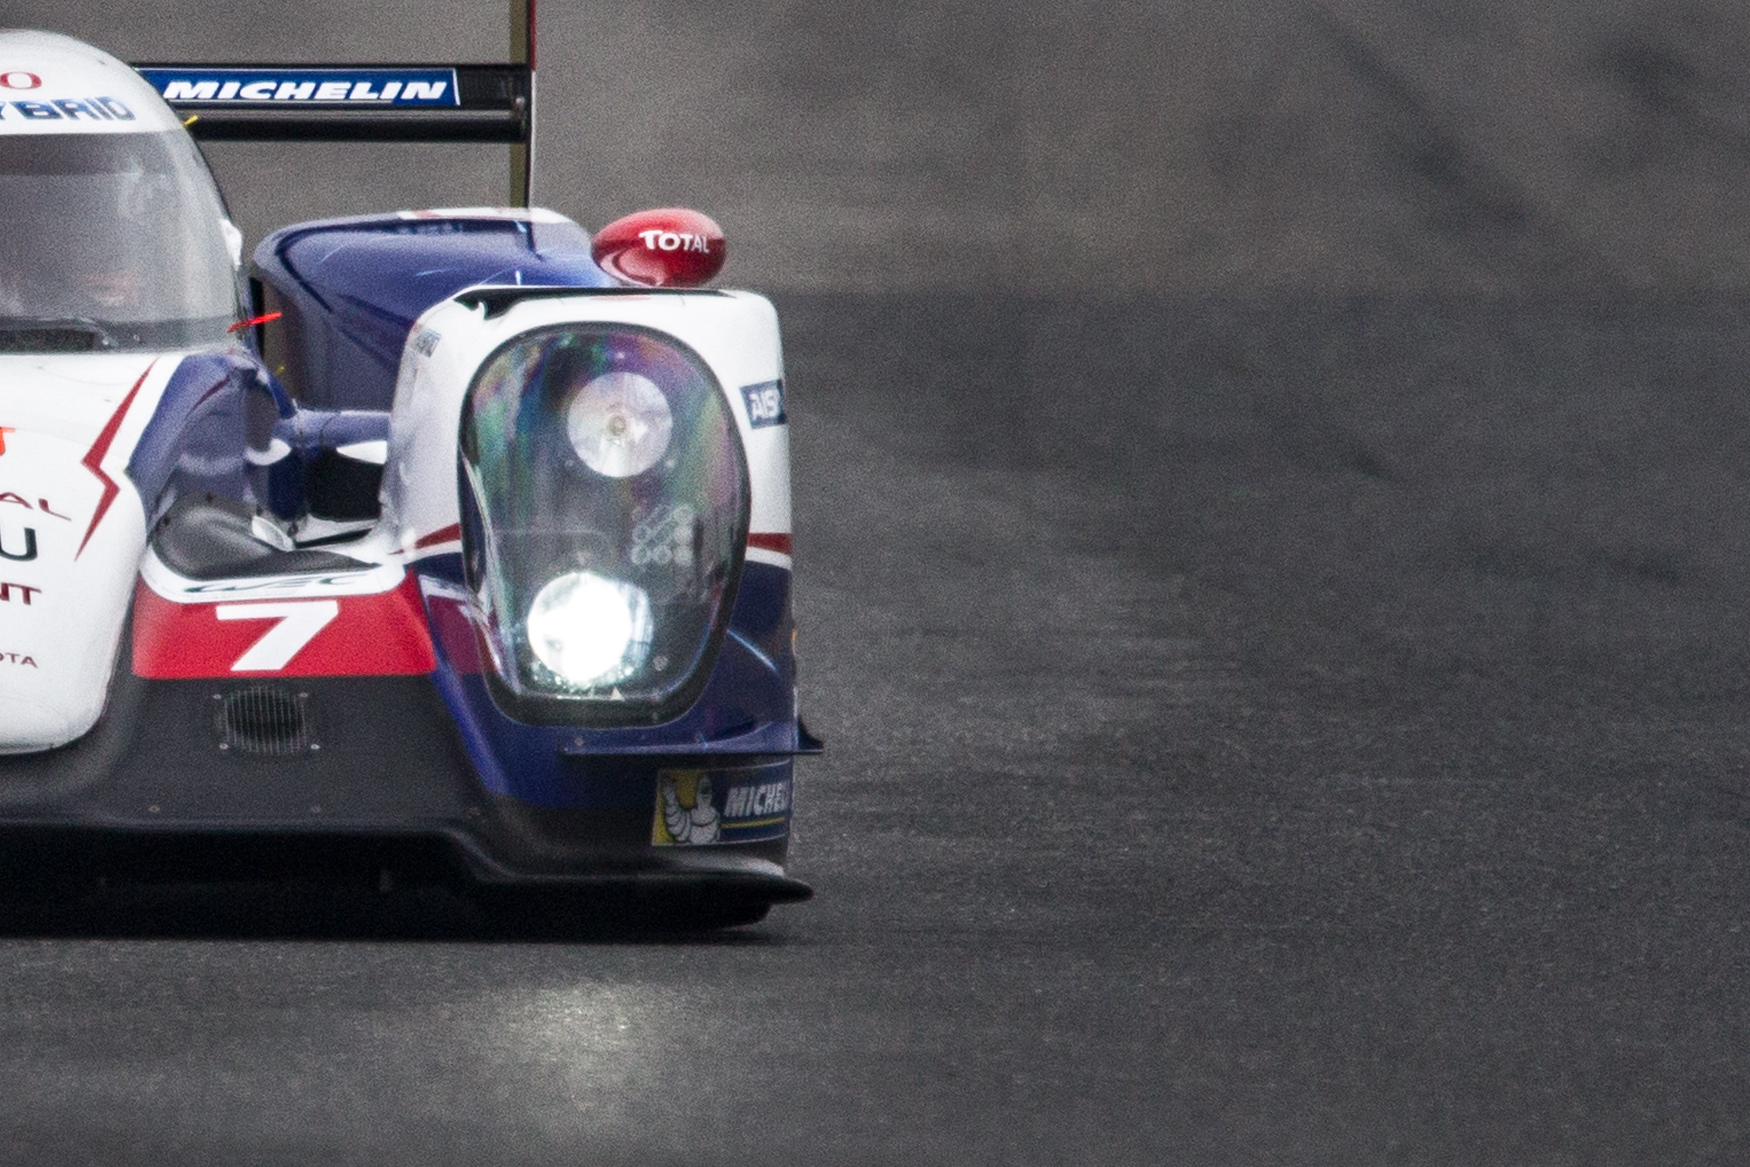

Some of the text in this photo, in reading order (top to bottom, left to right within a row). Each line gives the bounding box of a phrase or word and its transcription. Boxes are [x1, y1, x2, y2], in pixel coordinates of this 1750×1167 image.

[162, 81, 449, 101] MICHELIN
[638, 229, 710, 253] TOTAL
[215, 599, 340, 672] 7
